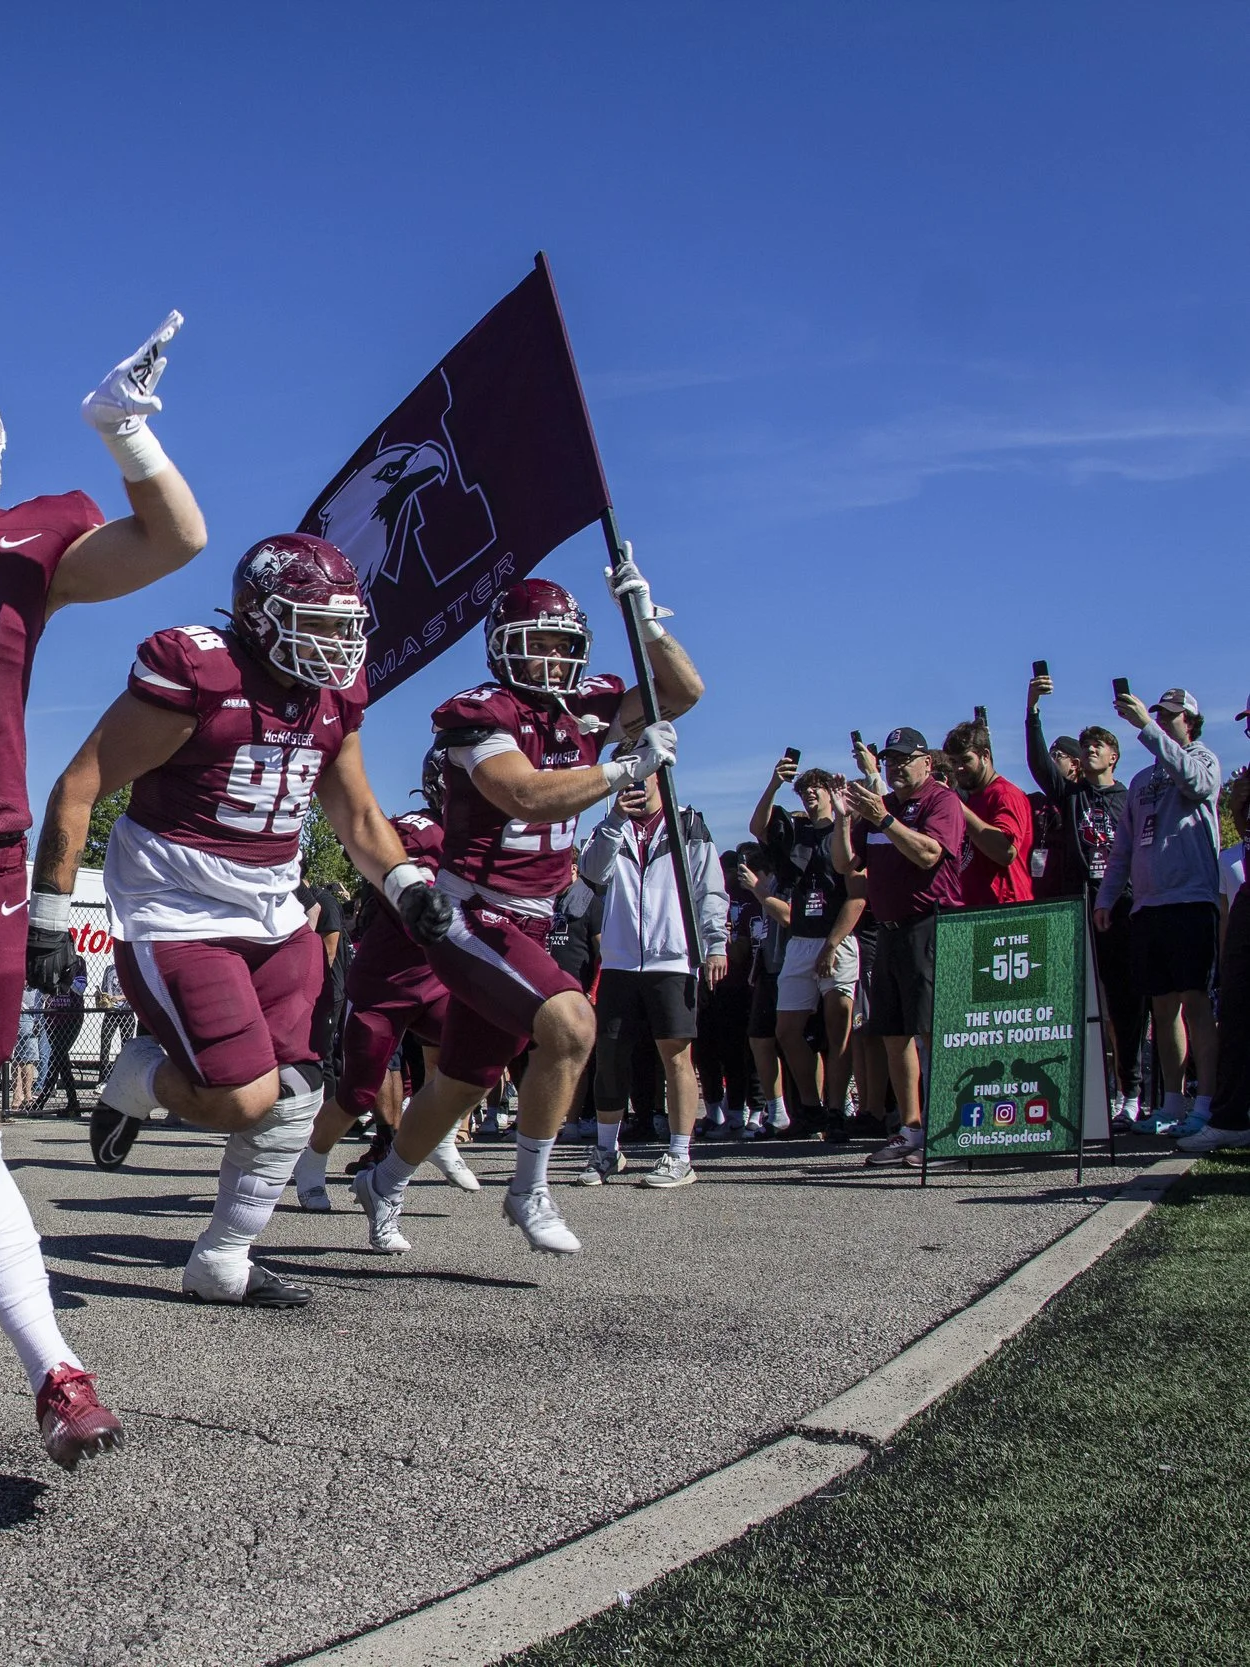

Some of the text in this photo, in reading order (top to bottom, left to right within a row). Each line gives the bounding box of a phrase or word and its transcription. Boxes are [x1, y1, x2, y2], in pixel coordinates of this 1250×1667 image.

[369, 551, 515, 687] MASTER
[263, 729, 315, 747] McMASTER
[215, 744, 324, 834] 98
[993, 934, 1029, 947] AT THE
[965, 1006, 1054, 1028] THE VOICE OF
[943, 1024, 1073, 1048] USPORTS FOOTBALL
[973, 1081, 1038, 1097] FIND US ON
[957, 1130, 1052, 1148] @the55podcast
